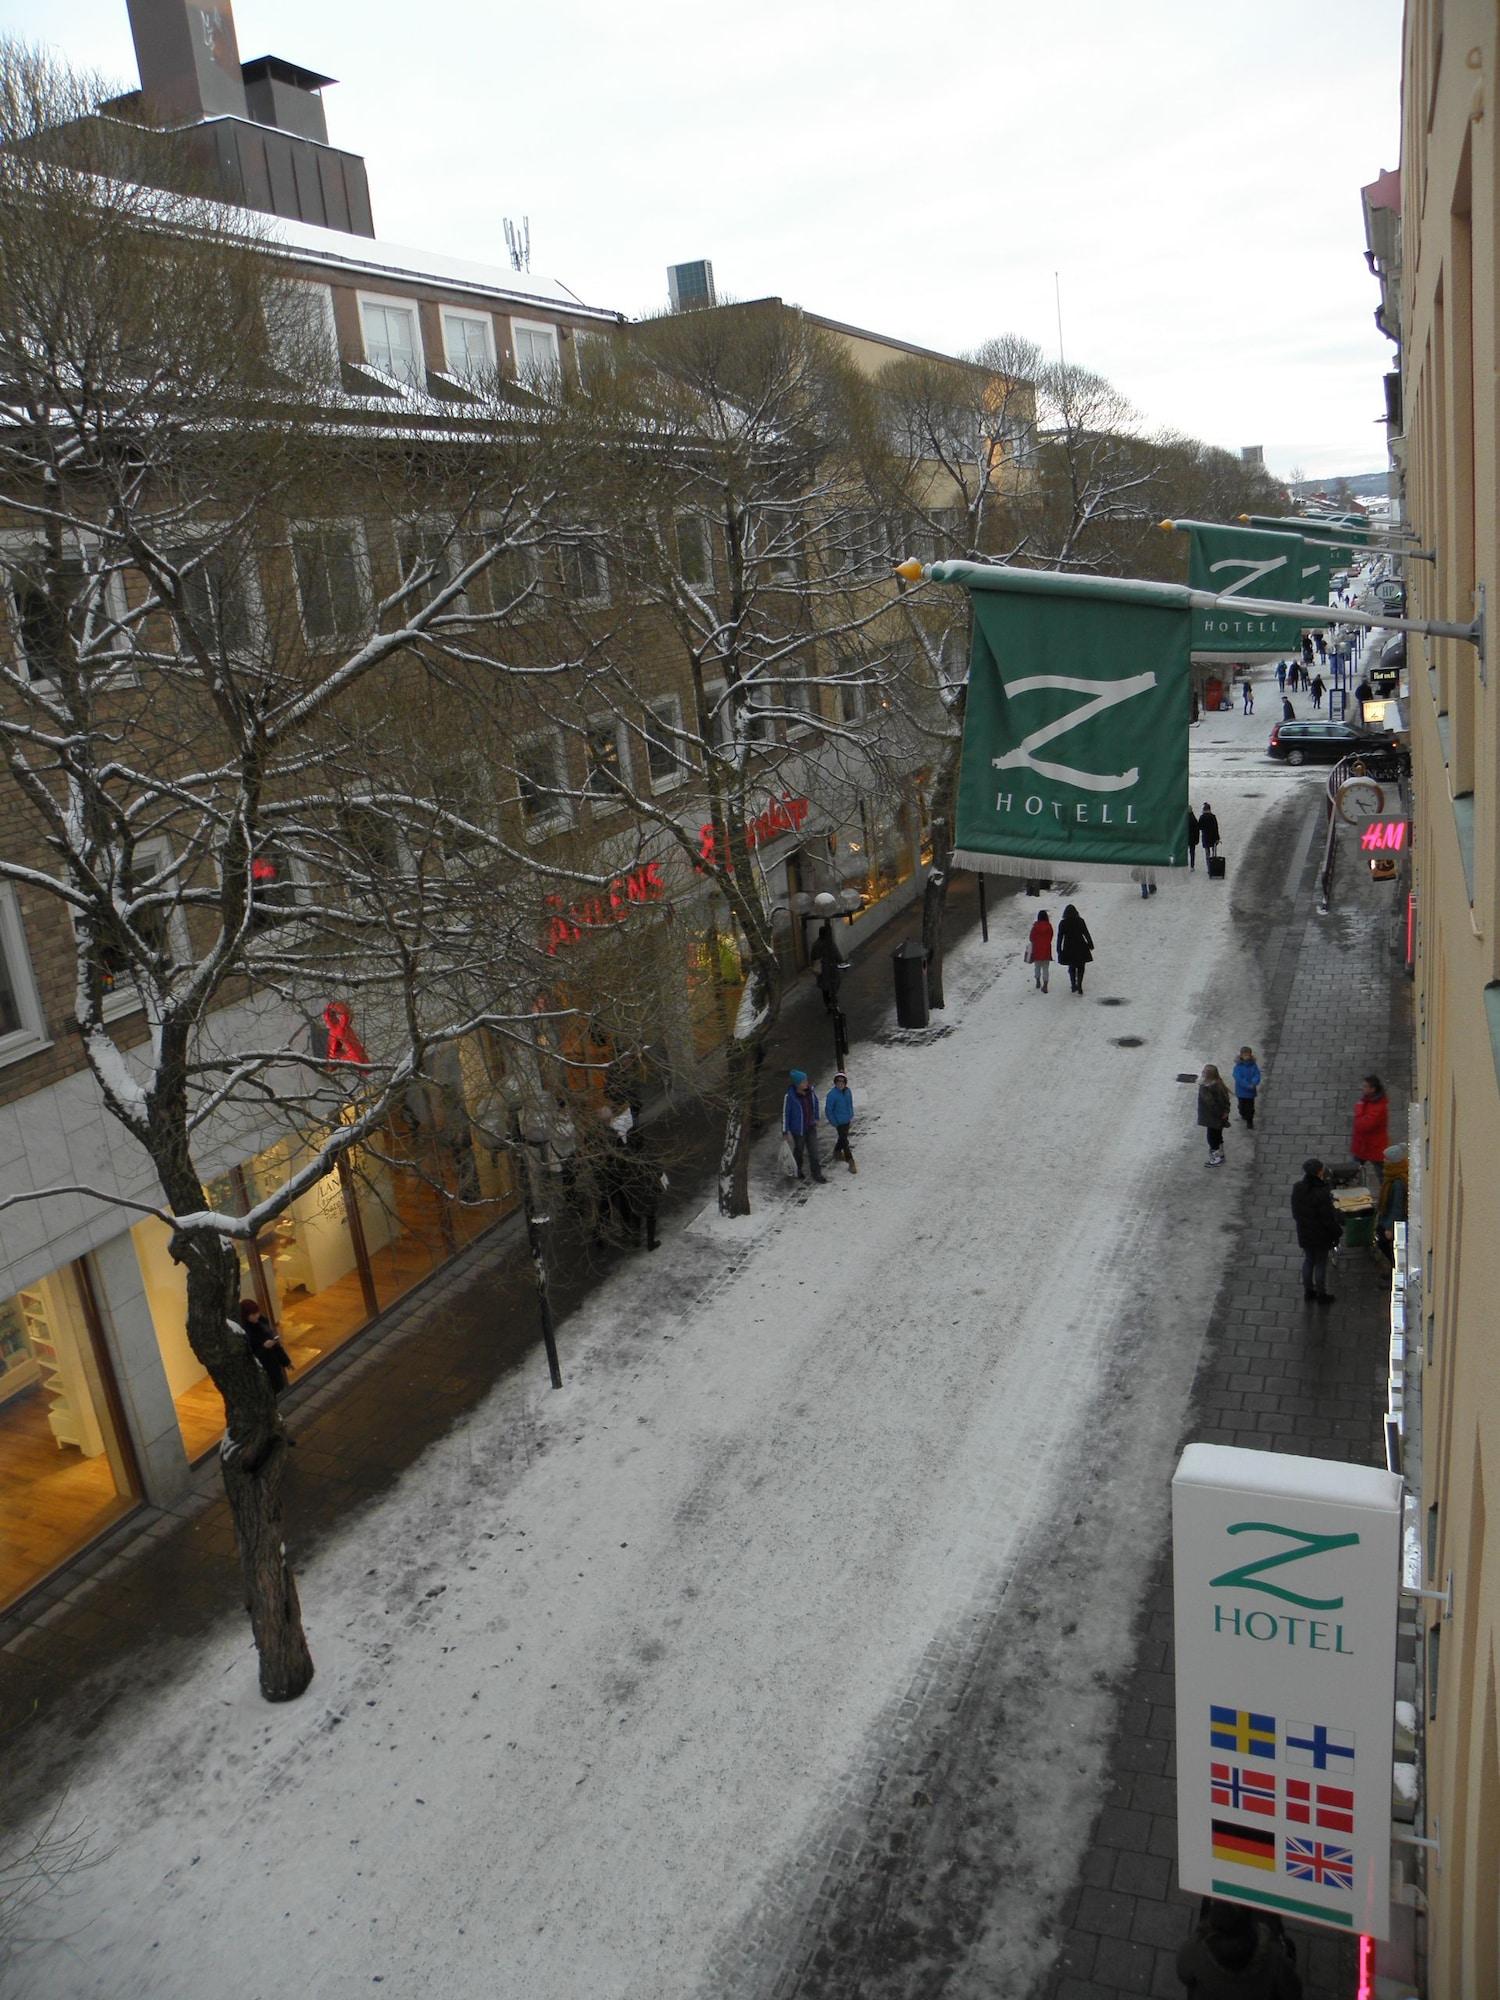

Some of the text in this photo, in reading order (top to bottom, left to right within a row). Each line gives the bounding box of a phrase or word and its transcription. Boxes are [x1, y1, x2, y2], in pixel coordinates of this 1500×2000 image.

[1204, 620, 1279, 633] HOTELL
[991, 671, 1158, 792] Z
[996, 792, 1138, 825] HOTELL
[1361, 822, 1405, 850] H&M
[1209, 1521, 1360, 1610] Z
[1214, 1605, 1354, 1655] HOTEL
